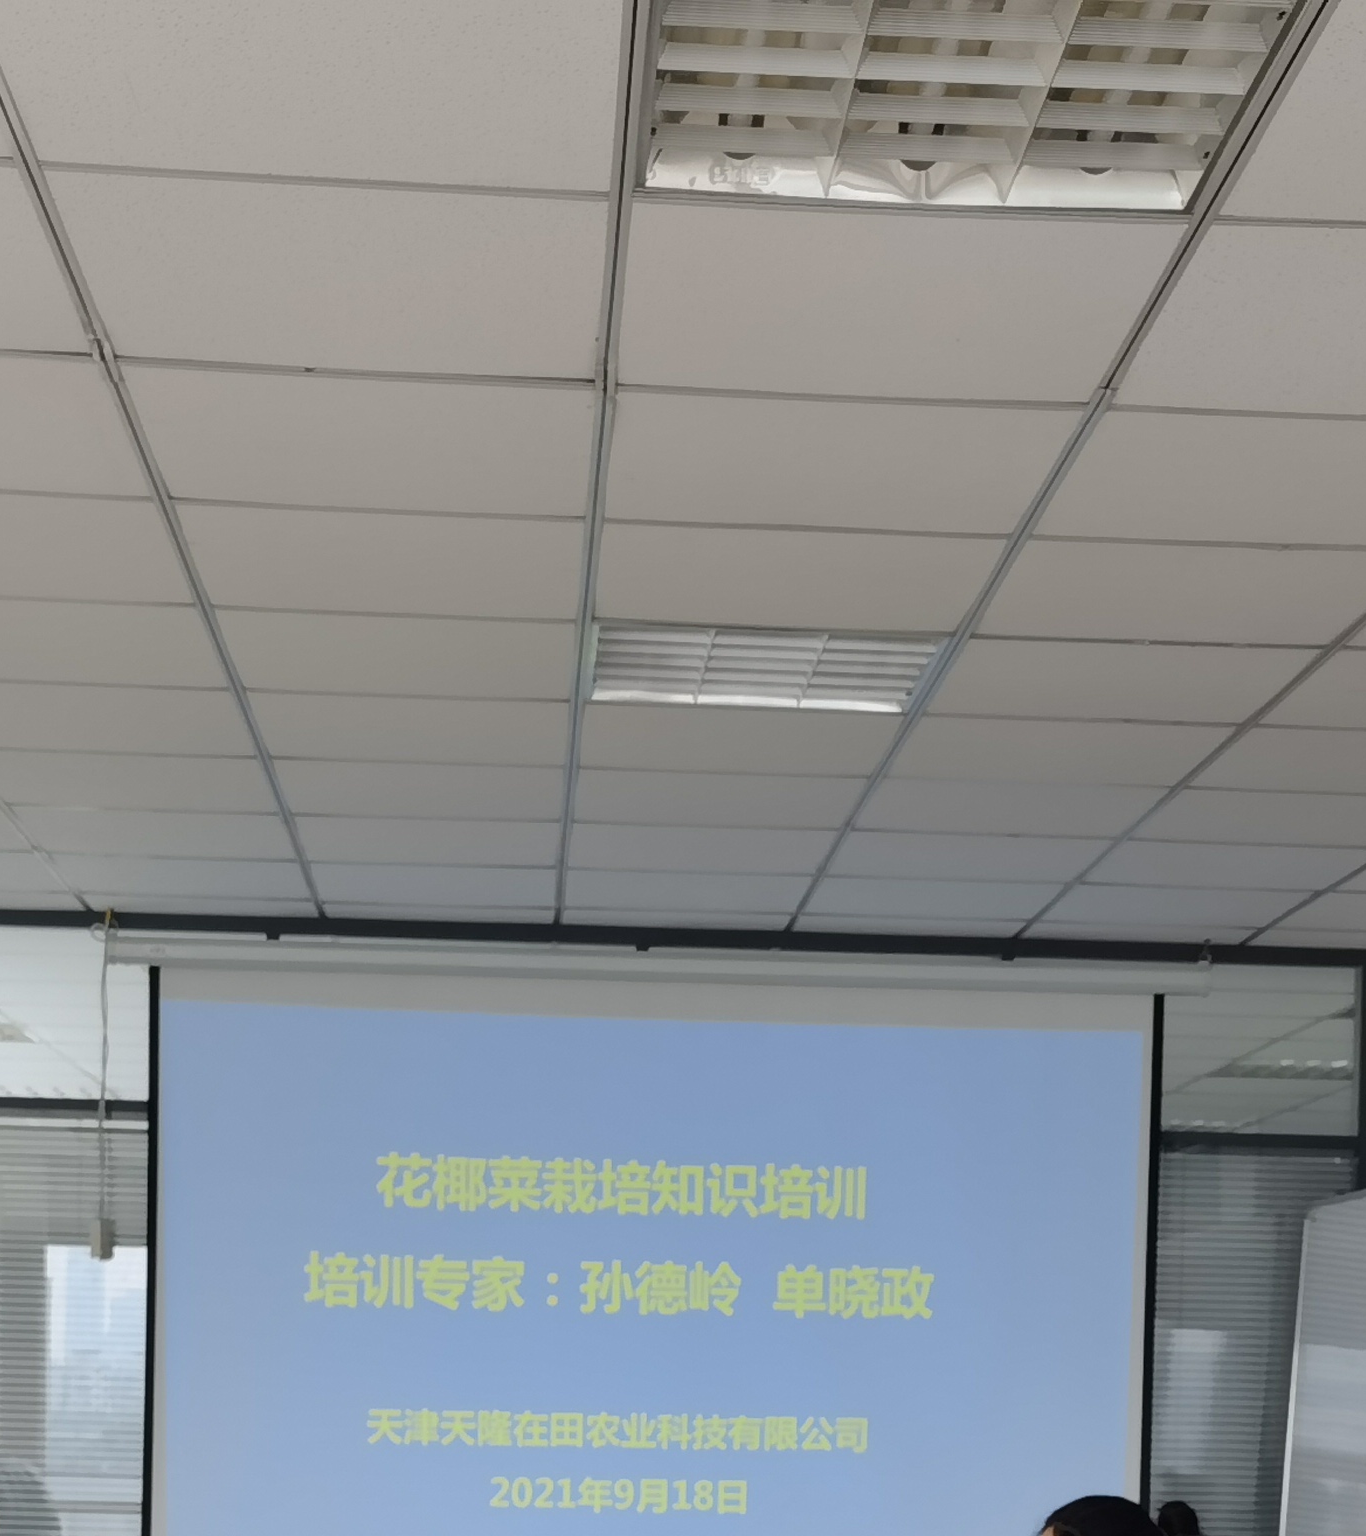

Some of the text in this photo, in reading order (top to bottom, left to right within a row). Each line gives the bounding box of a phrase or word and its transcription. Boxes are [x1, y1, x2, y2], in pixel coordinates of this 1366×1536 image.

[376, 1150, 868, 1221] 花椰菜栽培知识培训
[771, 1263, 936, 1321] 单晓政
[367, 1407, 870, 1455] 天津天隆在田农业科技有限公司
[489, 1475, 749, 1516] 2021年9月18日
